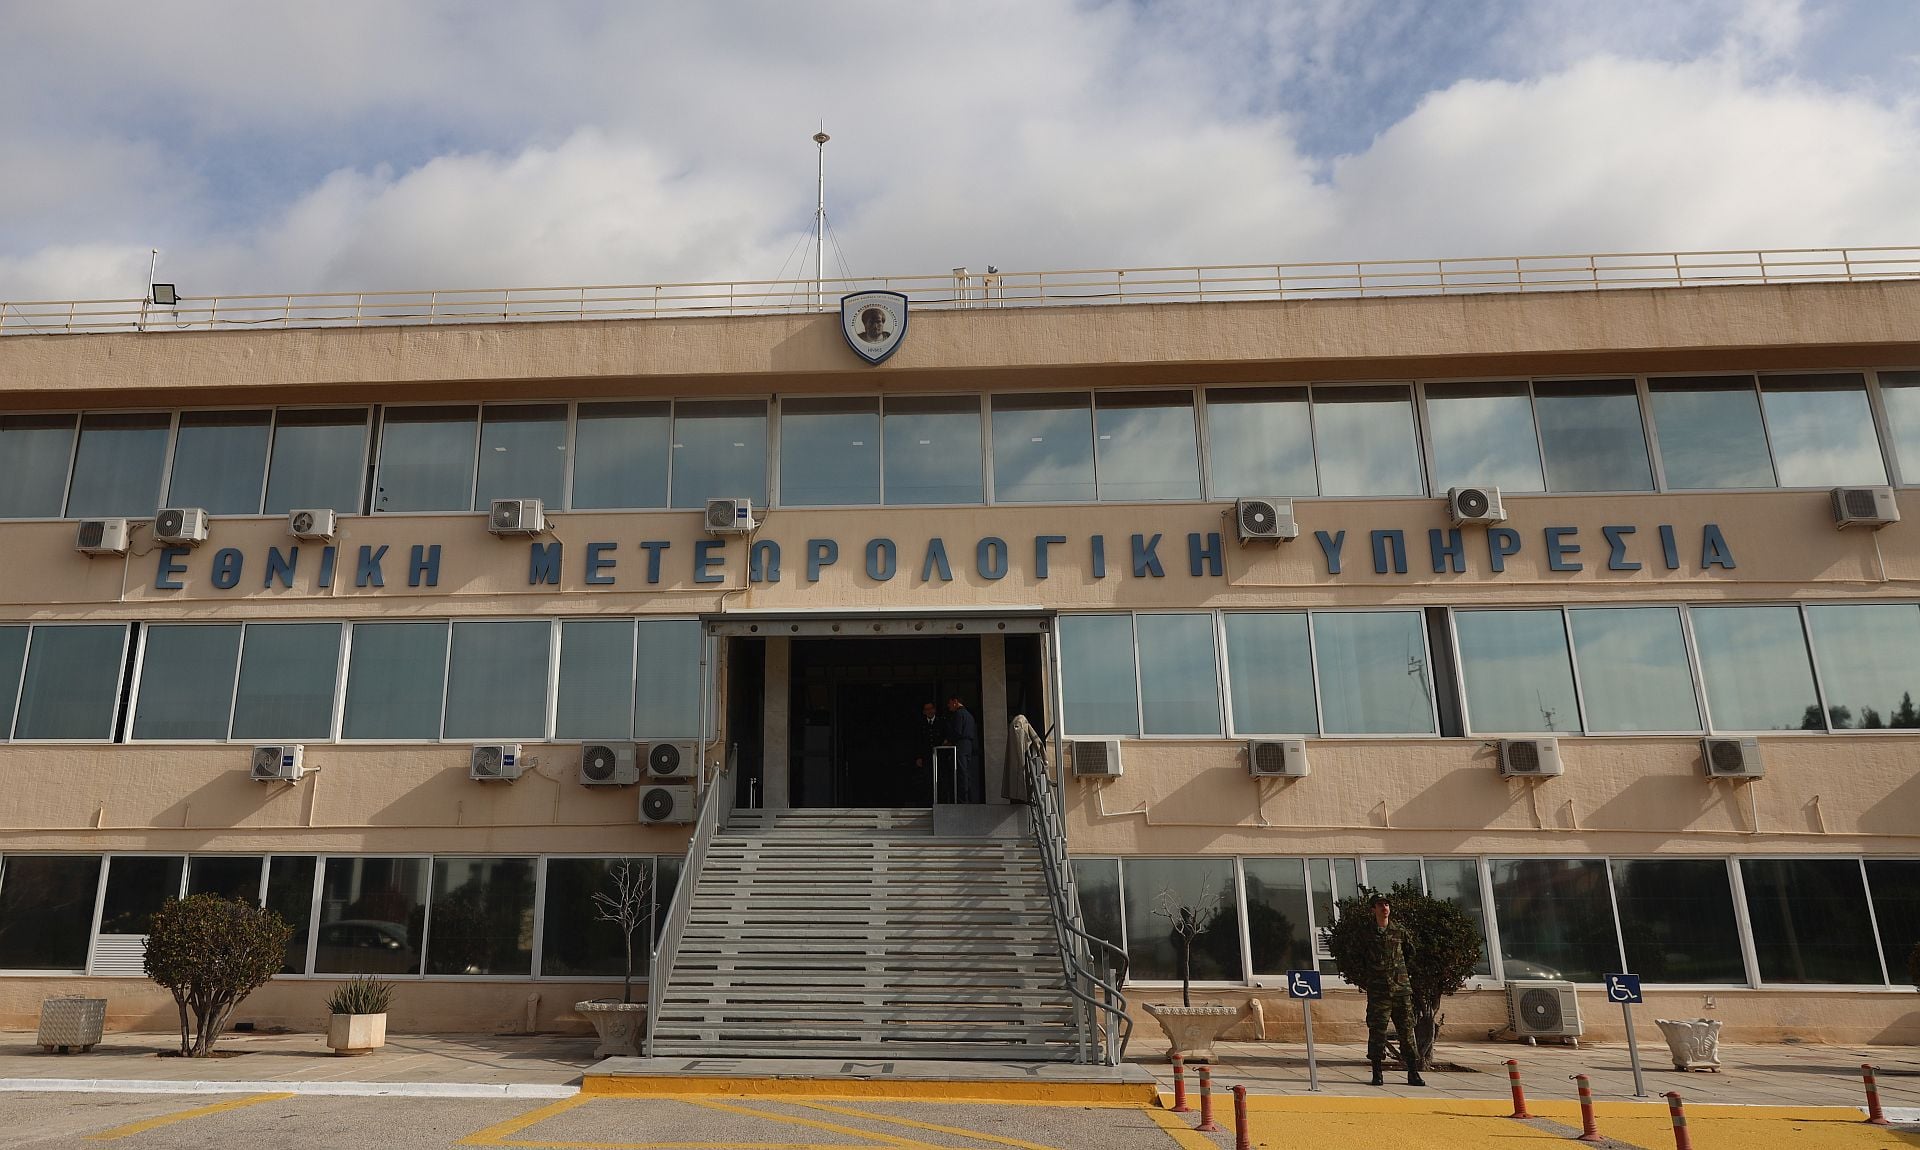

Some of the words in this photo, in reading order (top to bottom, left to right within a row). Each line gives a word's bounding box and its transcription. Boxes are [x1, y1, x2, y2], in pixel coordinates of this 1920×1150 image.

[155, 544, 442, 590] ΕΘΝΙΚΗ
[529, 532, 1224, 585] ΜΕΤΕΩΡΟΛΟΓΙΚΗ
[1314, 523, 1737, 574] ΥΠΗΡΕΣΙΑ
